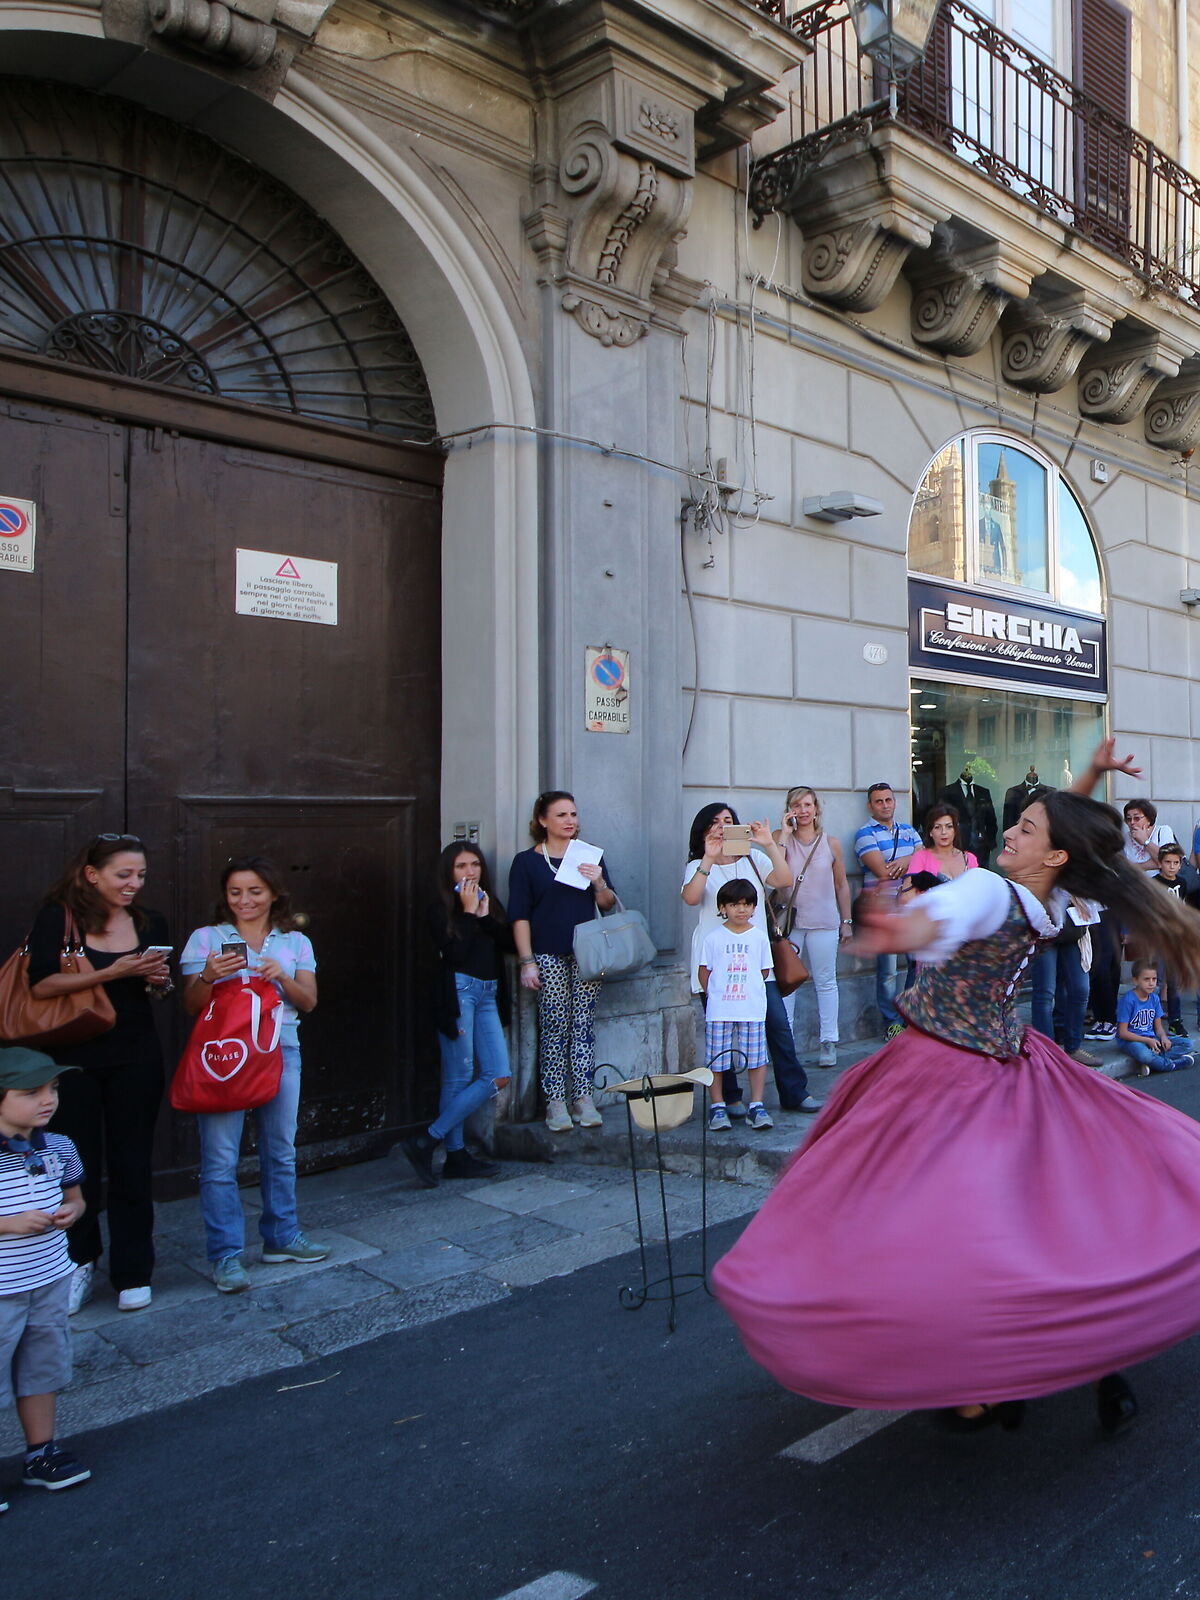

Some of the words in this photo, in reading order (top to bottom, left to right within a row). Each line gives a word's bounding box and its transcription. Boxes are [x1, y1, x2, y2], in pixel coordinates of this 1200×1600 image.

[0, 542, 20, 553] SSO
[260, 576, 290, 585] Lasciare
[292, 581, 313, 589] libero
[253, 583, 291, 594] passaggio
[293, 589, 325, 598] carrabile
[240, 590, 267, 598] sempre
[283, 594, 305, 603] giorni
[306, 597, 328, 606] festivi
[260, 607, 285, 616] giorno
[270, 600, 293, 609] giorni
[294, 604, 316, 612] feriali
[944, 602, 1083, 654] SIRCHIA
[928, 629, 988, 653] Confezioni
[989, 641, 1062, 665] Abbigliamento
[1064, 654, 1093, 670] Uomo
[596, 696, 621, 708] PASSO
[588, 710, 628, 723] CARRABILE
[726, 943, 750, 954] LIVE
